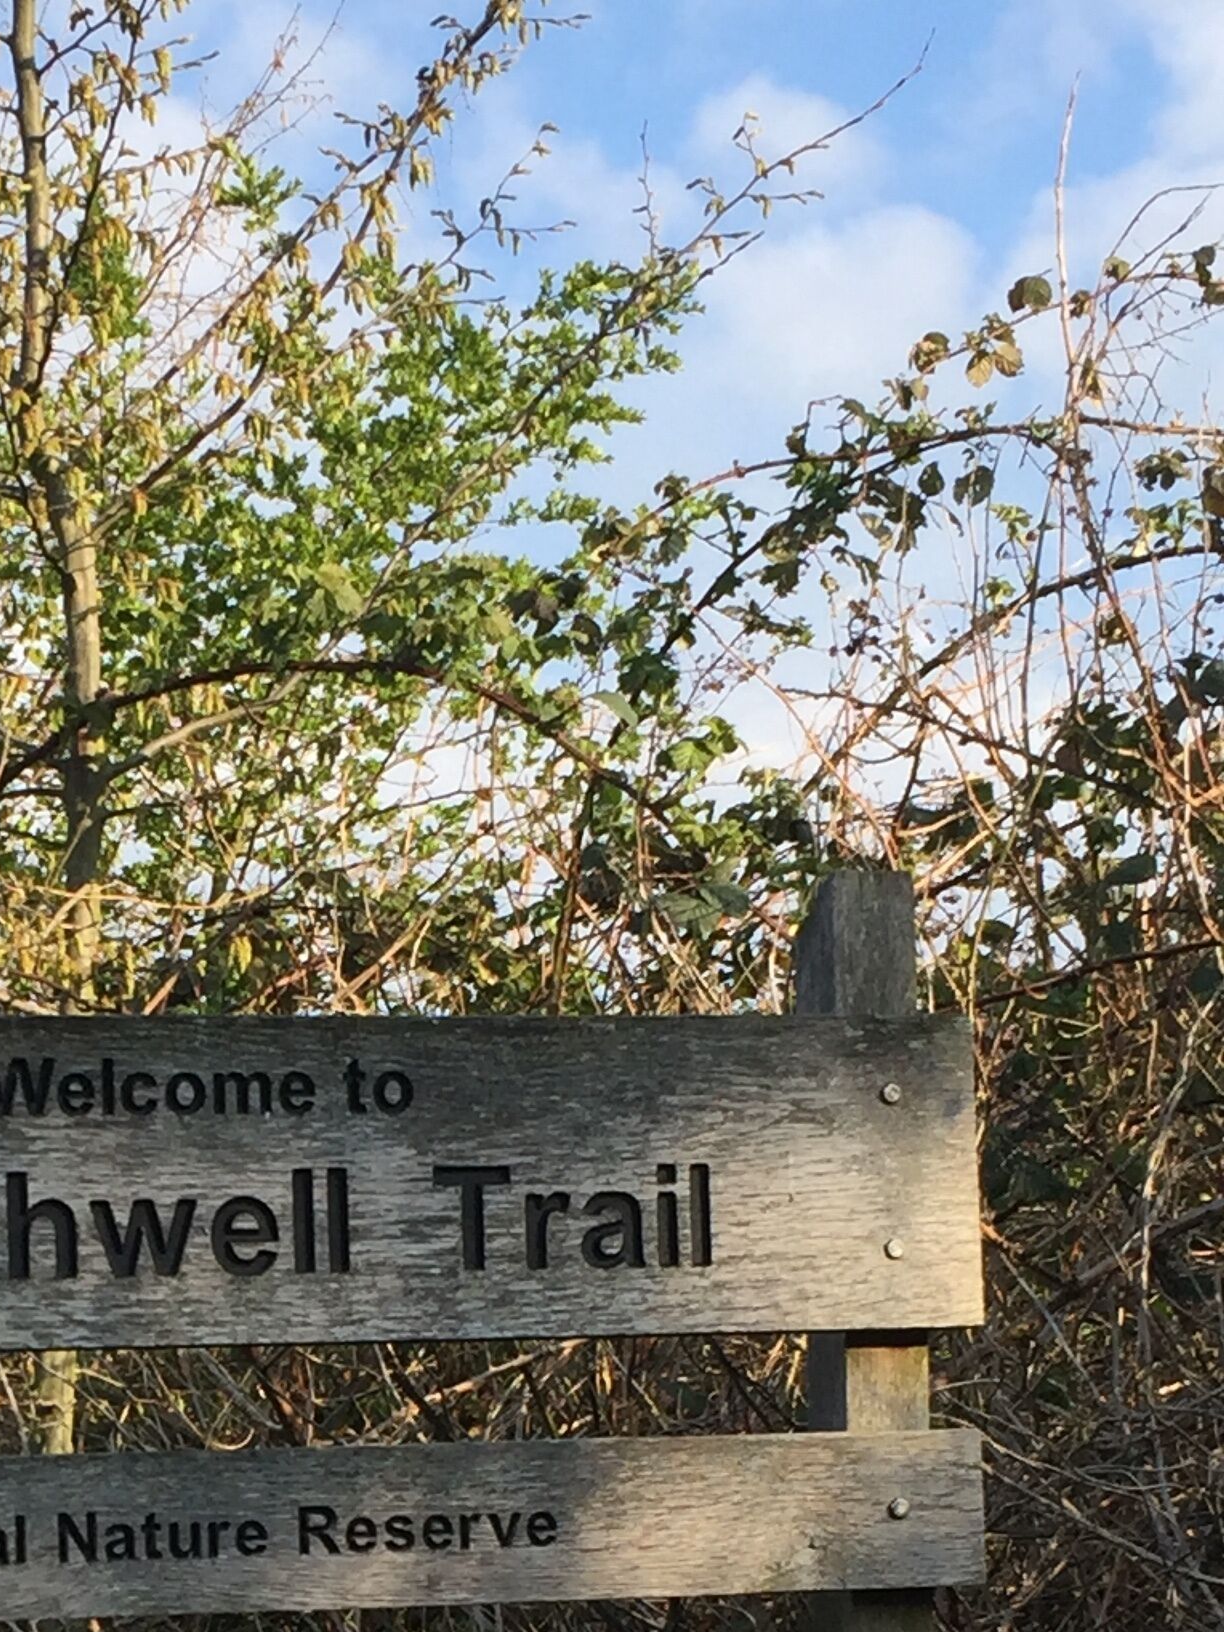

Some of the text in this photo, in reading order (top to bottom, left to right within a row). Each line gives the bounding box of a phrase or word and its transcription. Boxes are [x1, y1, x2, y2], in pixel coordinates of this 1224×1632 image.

[343, 1058, 415, 1116] to
[433, 1163, 712, 1271] Trail
[58, 1511, 269, 1565] Nature
[297, 1503, 559, 1556] Reserve
